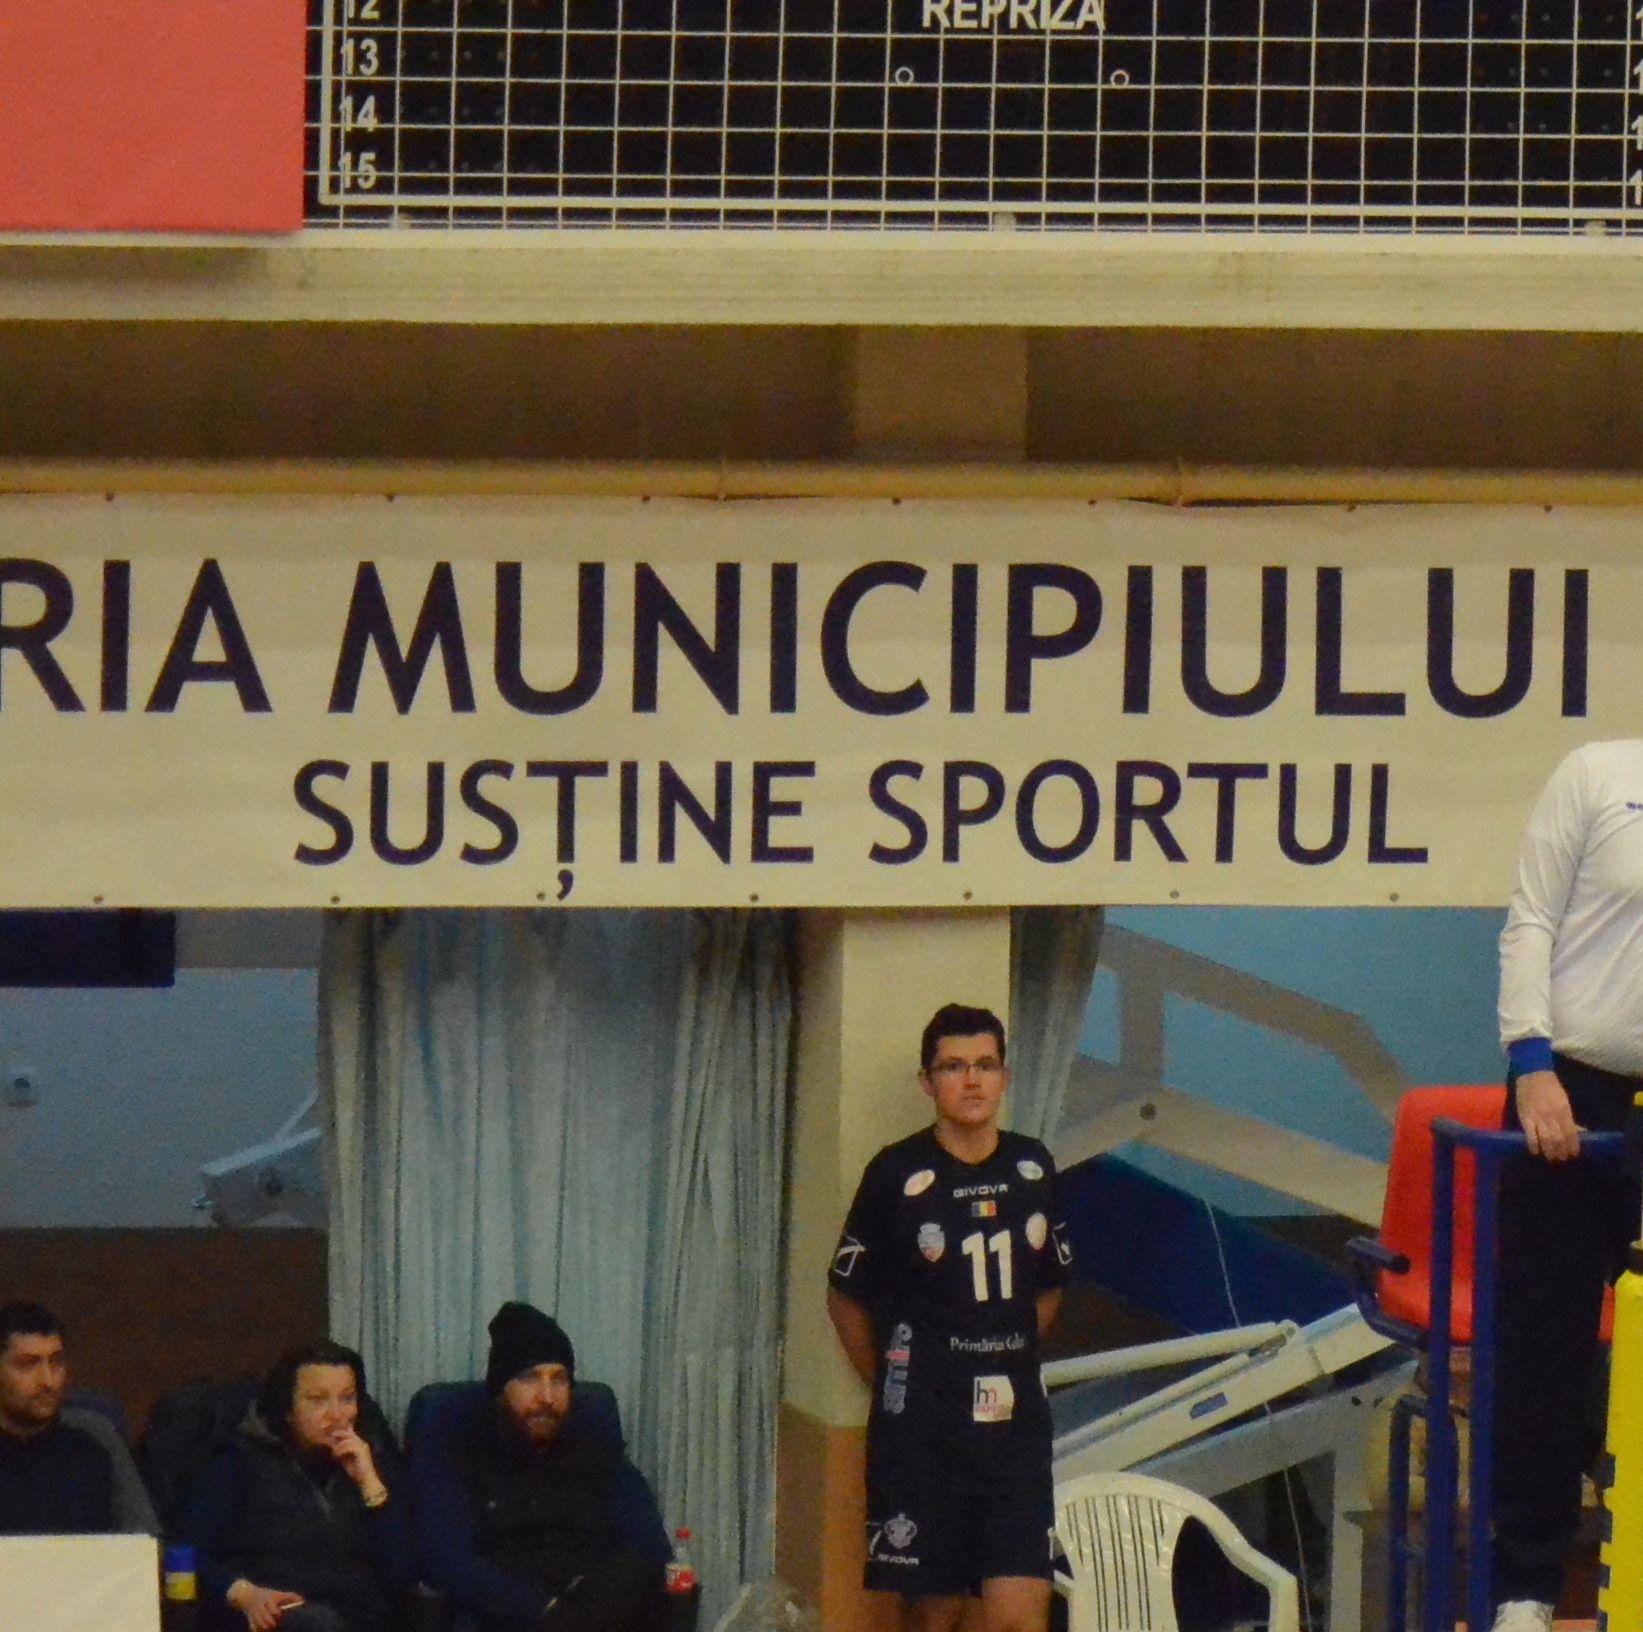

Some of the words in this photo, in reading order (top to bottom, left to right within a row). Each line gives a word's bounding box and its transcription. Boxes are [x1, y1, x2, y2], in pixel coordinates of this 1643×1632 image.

[922, 0, 1106, 30] REPRIZA
[340, 38, 380, 75] 13
[338, 94, 379, 133] 14
[338, 152, 377, 190] 15
[328, 559, 1589, 719] MUNICIPIULUI
[293, 758, 816, 901] SUSȚINE
[868, 758, 1429, 865] SPORTUL
[953, 1183, 1009, 1199] GIVOVA
[961, 1229, 1013, 1302] 11
